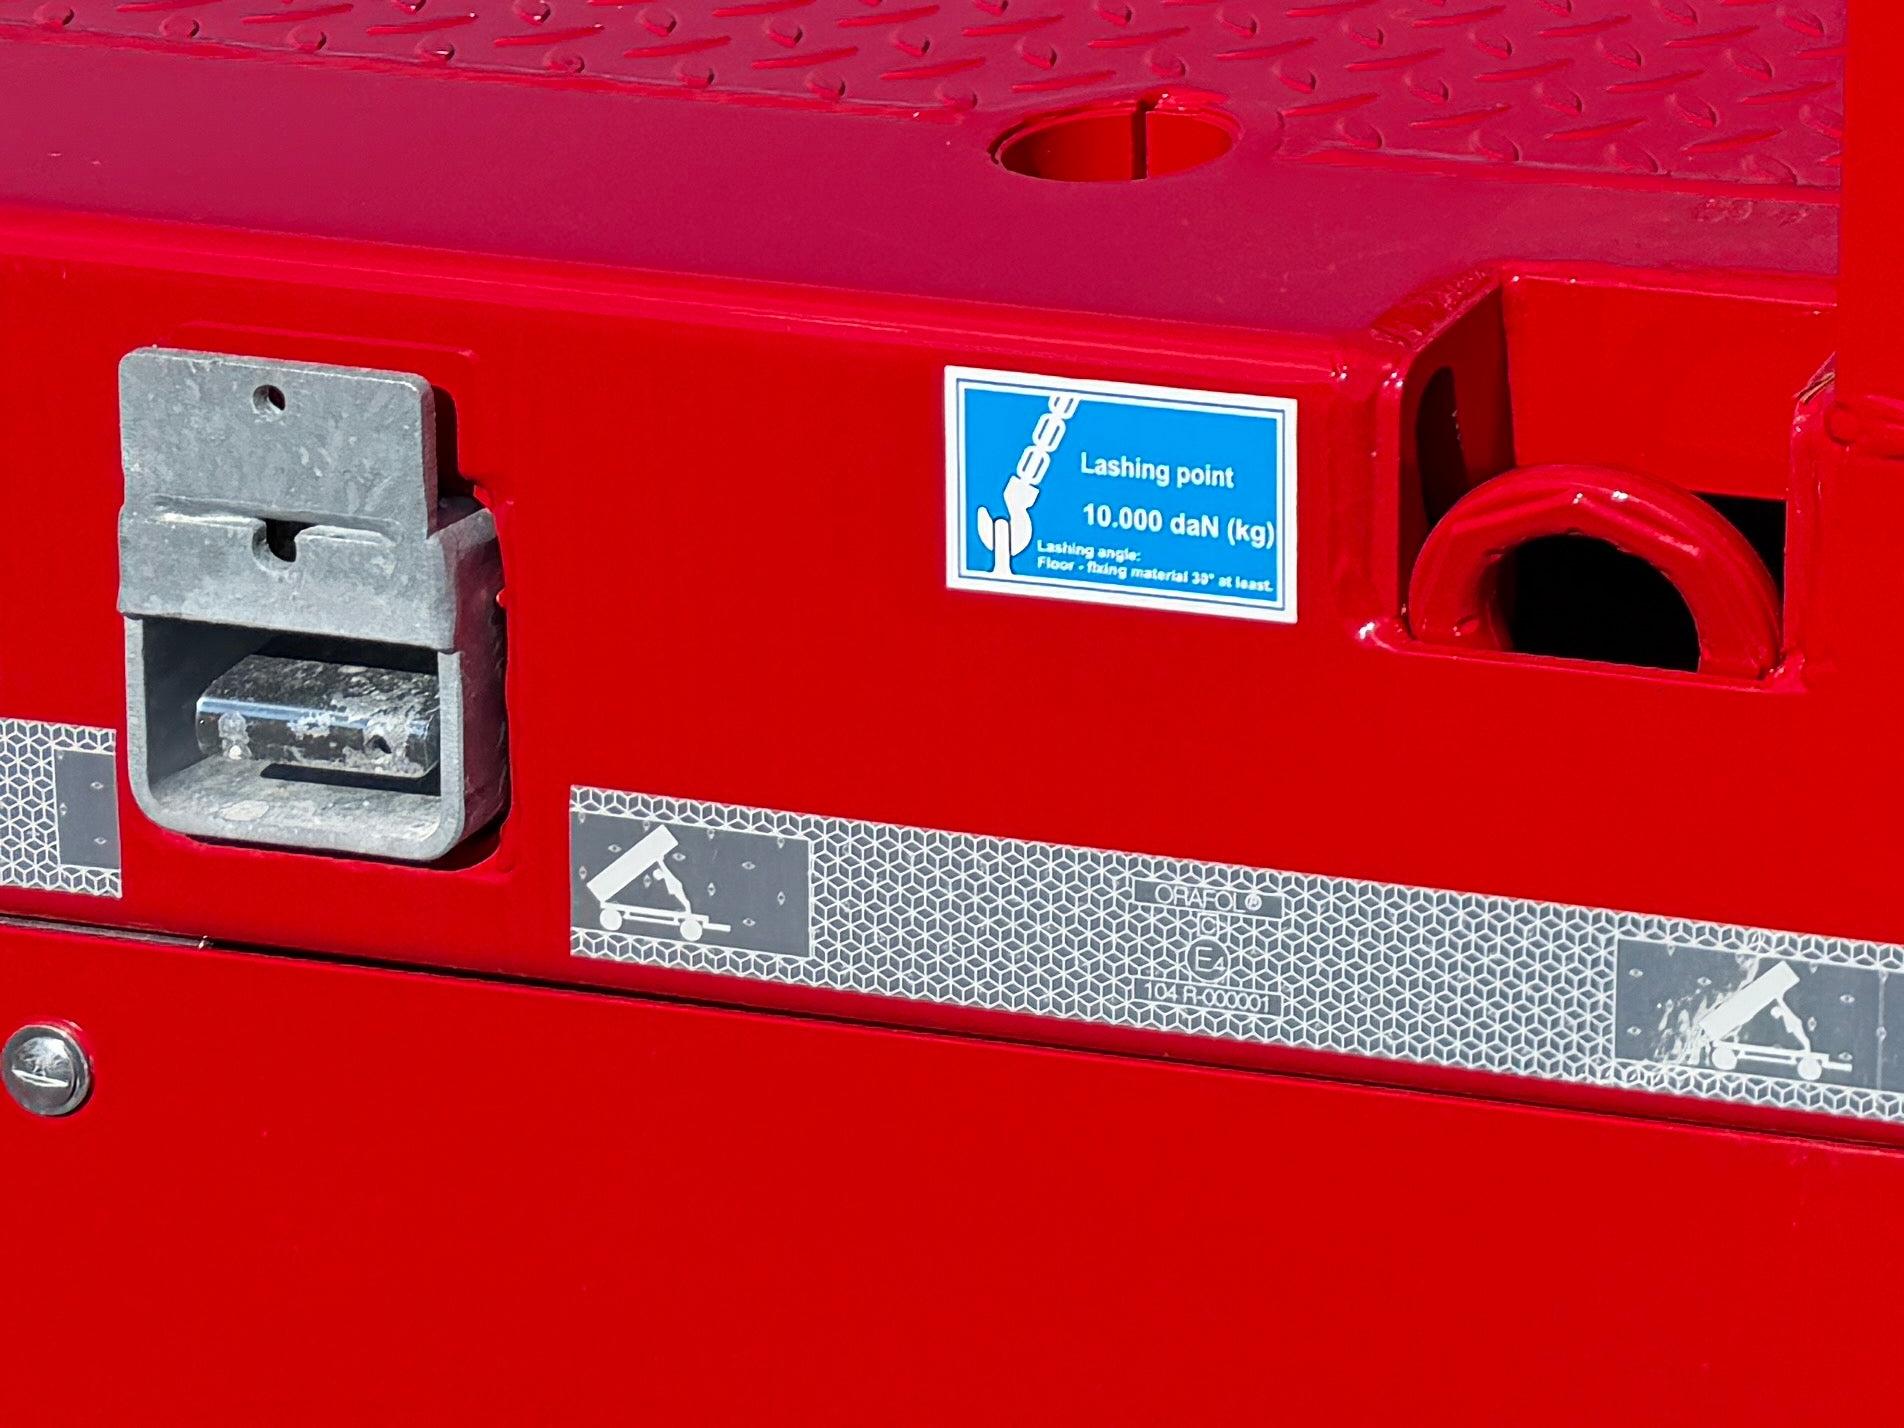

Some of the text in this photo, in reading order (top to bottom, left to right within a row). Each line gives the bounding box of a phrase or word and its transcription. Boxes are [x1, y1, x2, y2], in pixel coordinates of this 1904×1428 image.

[1081, 451, 1234, 489] Lashing point
[1083, 503, 1275, 550] 10.000 daN (kg)
[1037, 539, 1141, 563] Lashing angle:
[1037, 556, 1075, 571] Floor
[1130, 567, 1189, 583] material
[1144, 982, 1177, 1001] 104
